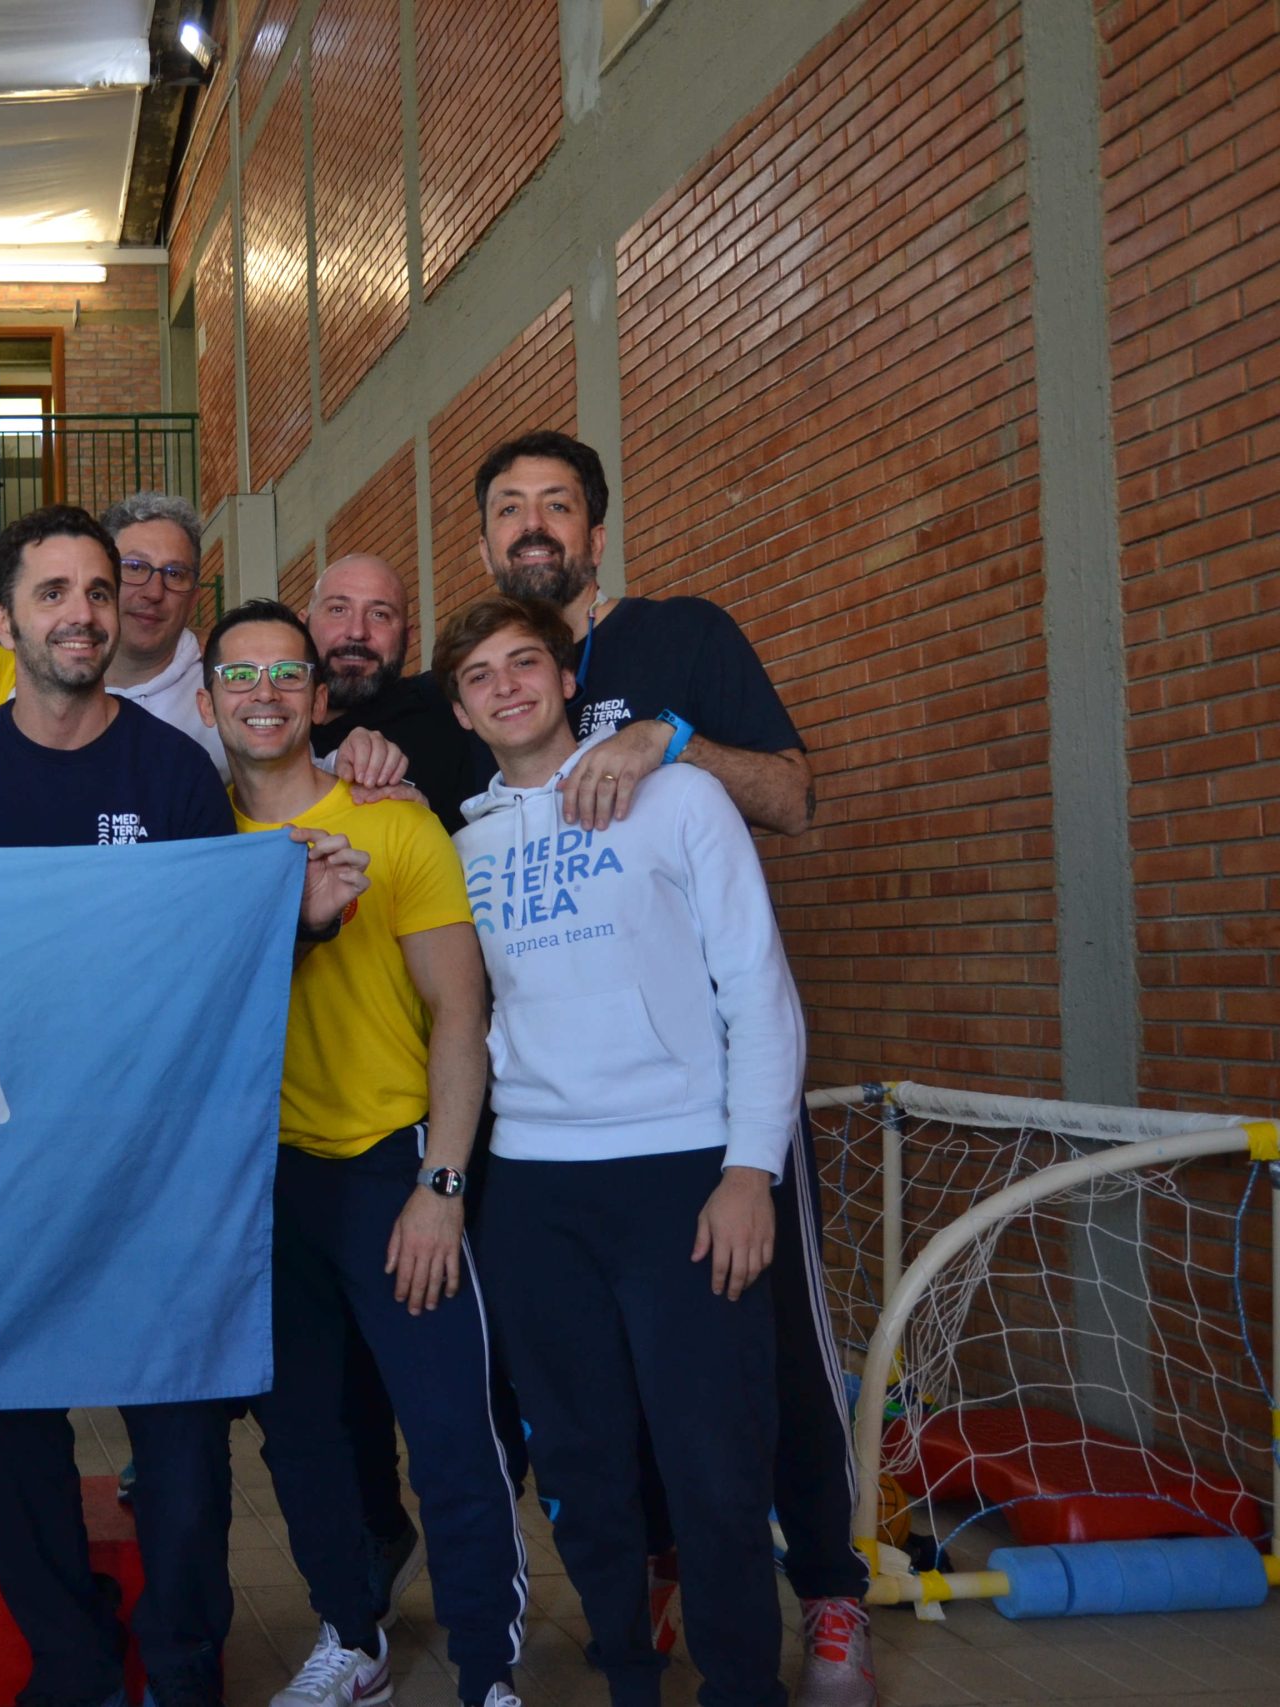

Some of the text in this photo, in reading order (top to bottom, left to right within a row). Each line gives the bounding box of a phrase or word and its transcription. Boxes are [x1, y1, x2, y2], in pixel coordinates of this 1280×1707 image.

[594, 698, 625, 712] MEDI
[592, 708, 631, 722] TERRA
[112, 813, 141, 825] MEDI
[111, 825, 148, 838] TERRA
[505, 829, 594, 870] MEDI
[505, 923, 616, 957] apnea team
